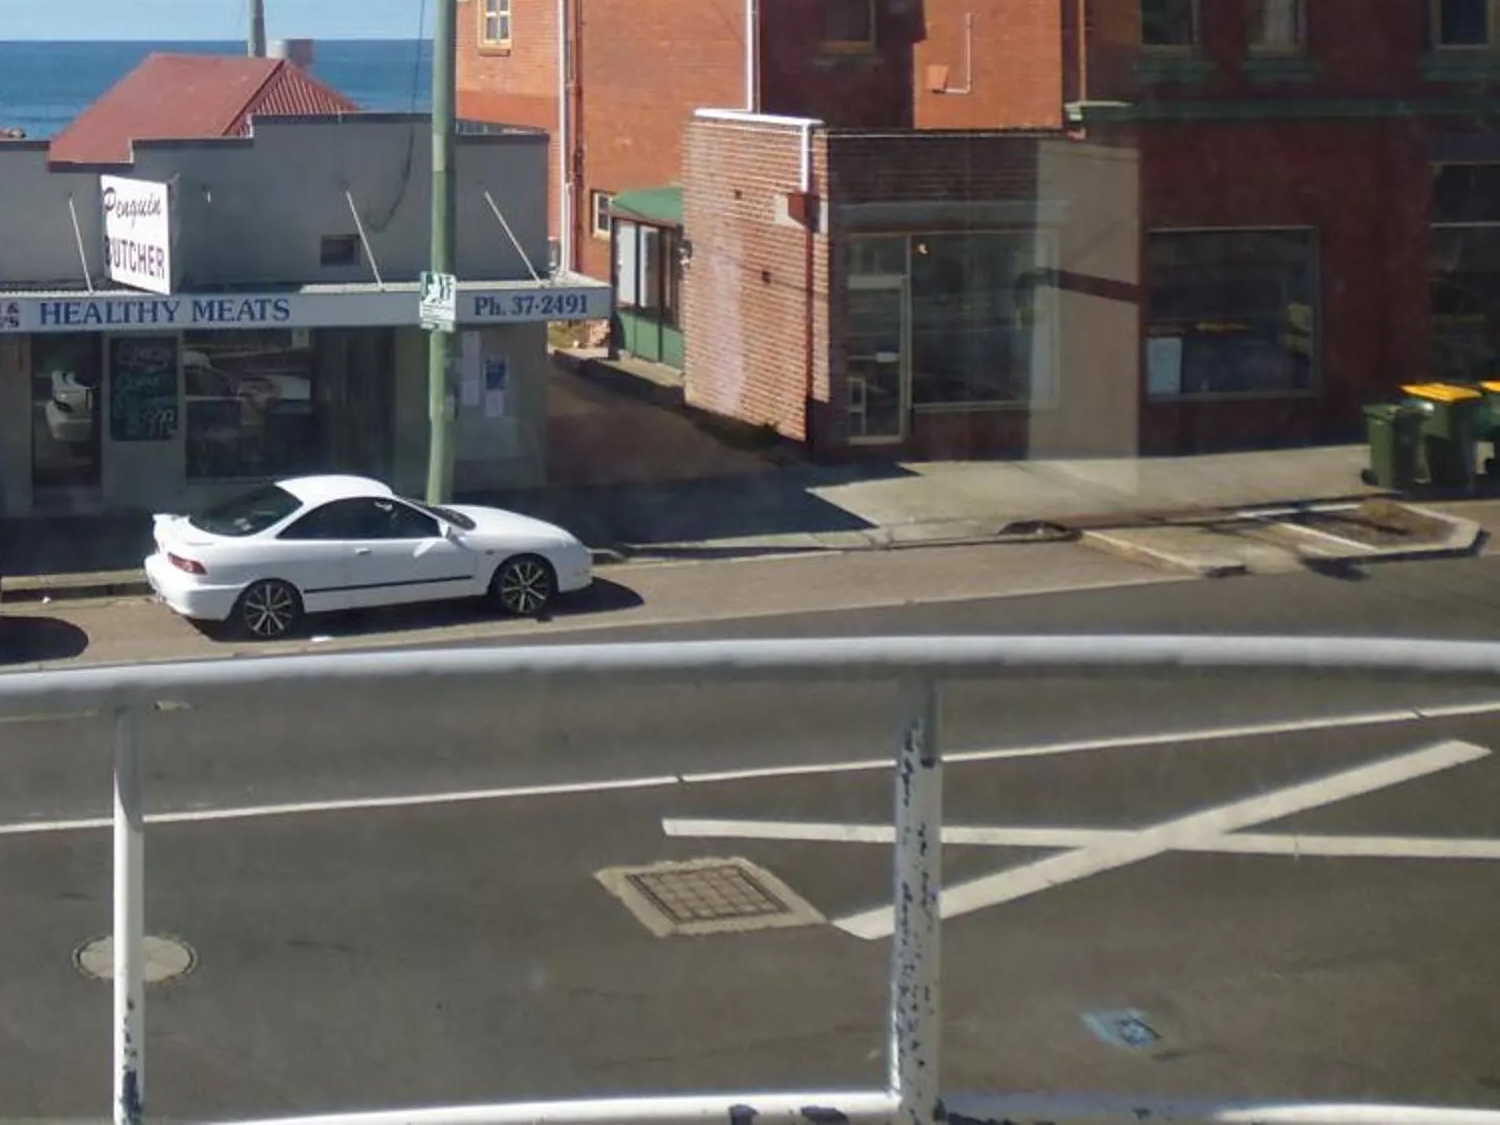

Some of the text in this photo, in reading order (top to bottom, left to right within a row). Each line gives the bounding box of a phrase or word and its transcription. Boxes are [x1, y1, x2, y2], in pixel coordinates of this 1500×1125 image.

[103, 186, 163, 229] Penguin
[7, 302, 20, 315] &
[40, 299, 290, 325] HEALTHY MEATS
[474, 295, 506, 316] Ph.
